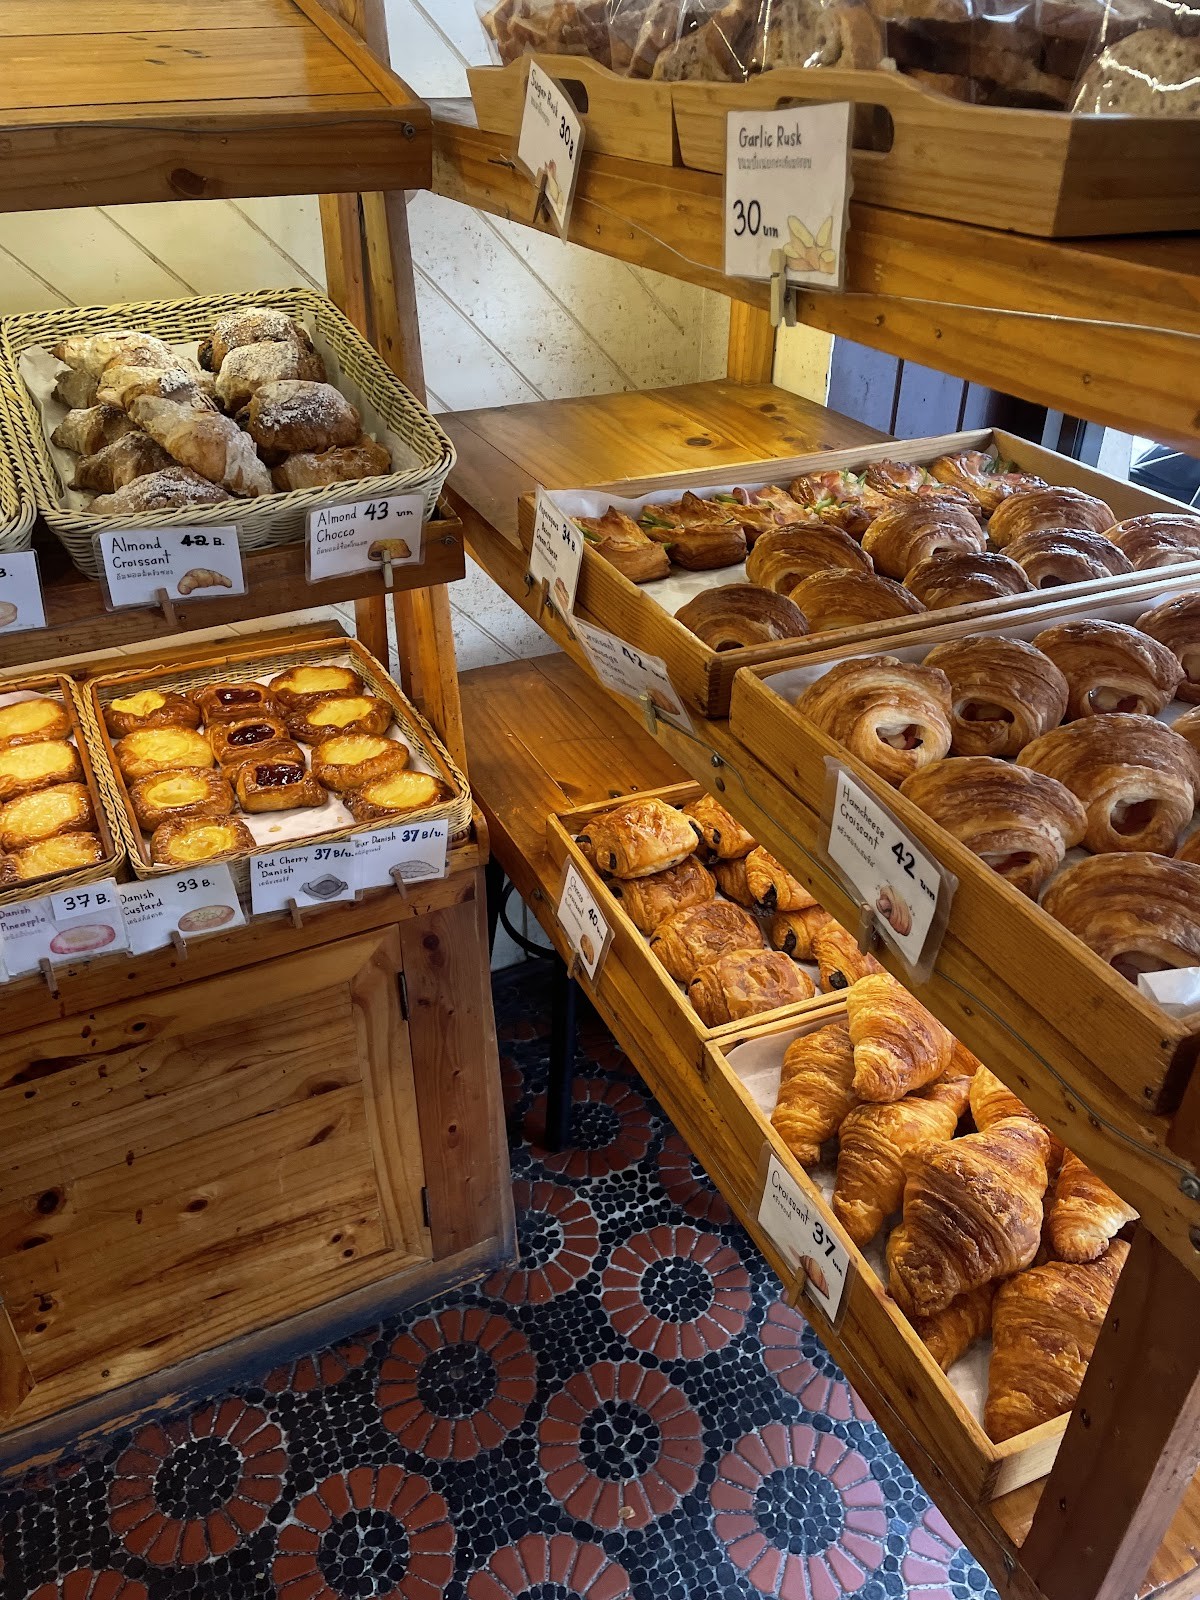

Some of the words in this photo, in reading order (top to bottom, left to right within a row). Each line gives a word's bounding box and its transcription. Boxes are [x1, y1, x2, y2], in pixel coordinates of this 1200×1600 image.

[739, 125, 773, 148] Garlic
[777, 122, 802, 147] Rusk
[733, 199, 761, 236] 30
[317, 506, 357, 527] Almond
[364, 501, 389, 520] 43
[180, 534, 209, 547] 42
[213, 537, 225, 546] B.
[316, 528, 355, 542] Chocco
[562, 523, 571, 545] 34
[111, 536, 162, 554] Almond
[112, 550, 172, 569] Croissant
[622, 646, 648, 672] 42
[840, 803, 880, 850] Croissant
[371, 832, 396, 844] Danish
[401, 829, 420, 843] 37
[257, 861, 275, 870] Red
[279, 855, 309, 866] Cherry
[313, 848, 332, 861] 37
[891, 841, 915, 879] 42
[261, 866, 294, 879] Danish
[177, 878, 198, 893] 33
[63, 894, 90, 911] 37
[96, 893, 111, 904] B.
[120, 889, 154, 905] Danish
[0, 906, 31, 919] Danish
[123, 899, 164, 916] Custard
[0, 916, 46, 932] Pineapple
[771, 1170, 810, 1226] Croissant
[812, 1221, 836, 1257] 37
